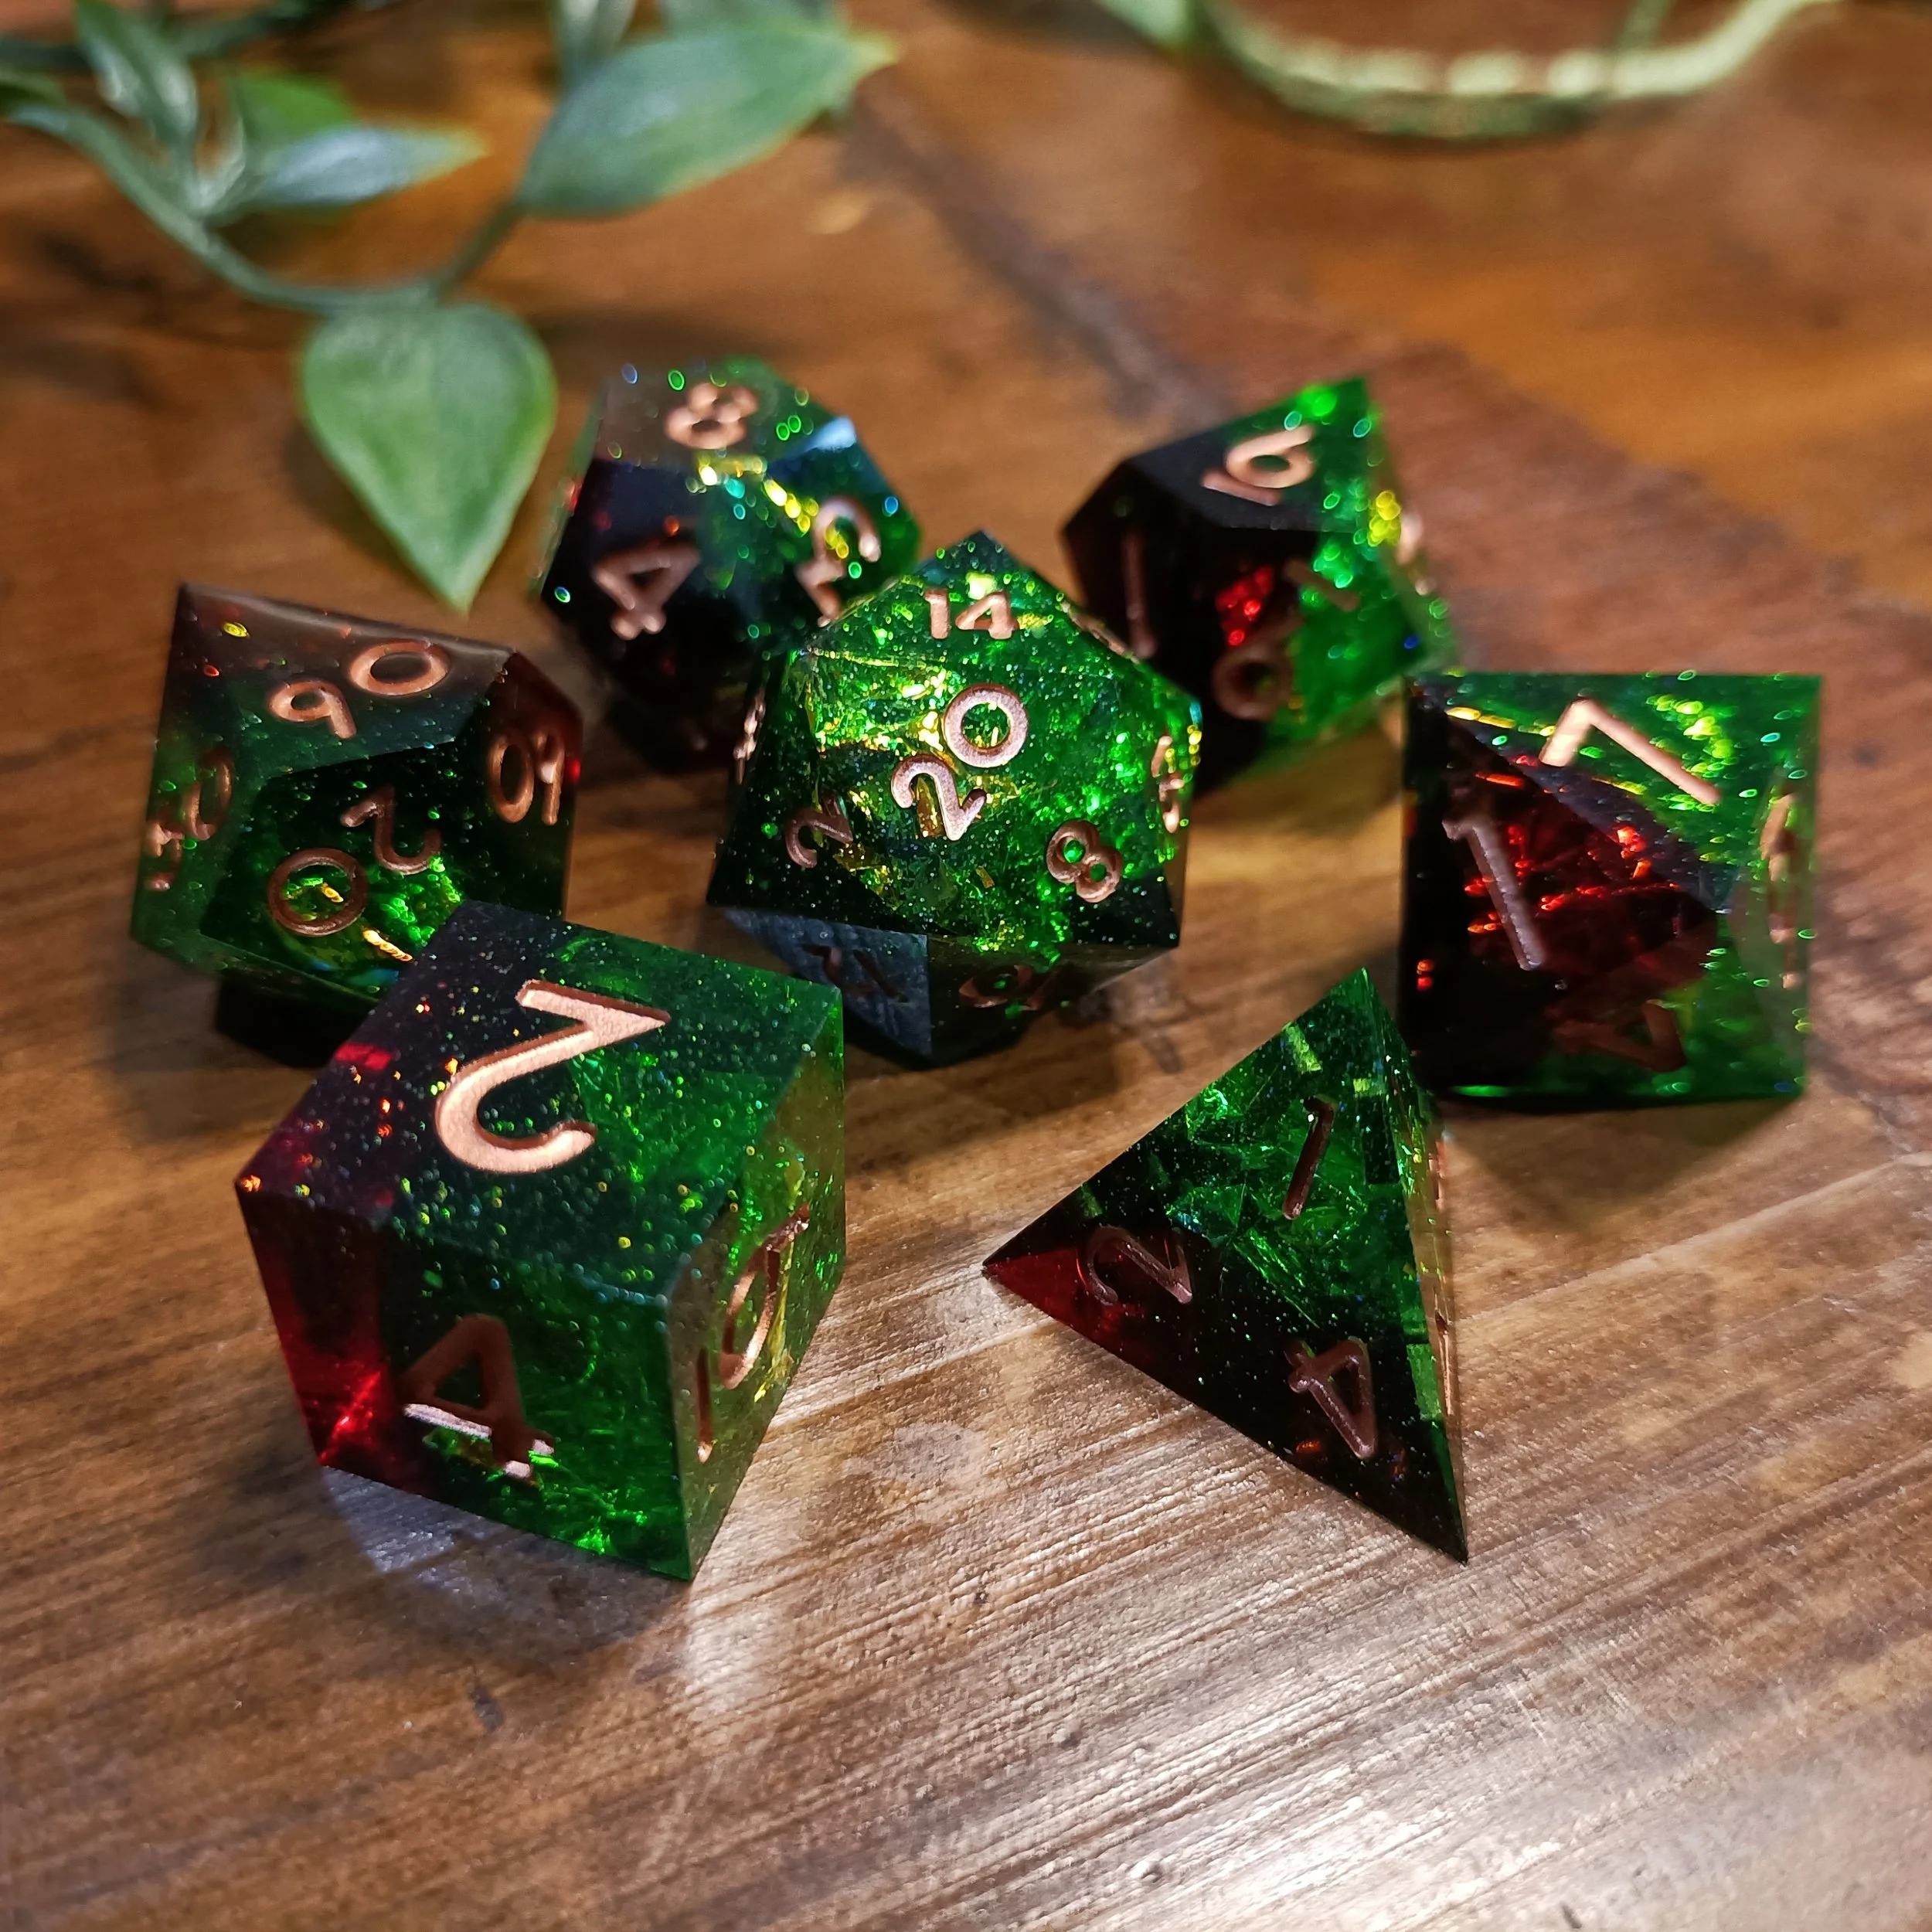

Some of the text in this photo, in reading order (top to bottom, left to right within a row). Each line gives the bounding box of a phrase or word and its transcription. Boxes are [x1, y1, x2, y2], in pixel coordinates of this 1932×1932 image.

[664, 383, 759, 451] 8
[924, 589, 1020, 639] 14
[267, 638, 453, 740] 90
[891, 683, 1029, 842] 20
[1541, 697, 1720, 804] 7
[267, 781, 443, 937] 20
[784, 791, 853, 869] 2
[1046, 819, 1123, 903] 8
[1442, 811, 1546, 971] 1
[435, 979, 672, 1173] 2
[1282, 1094, 1338, 1219] 1
[1084, 1225, 1192, 1305] 2
[398, 1314, 555, 1480] 4
[1284, 1336, 1377, 1459] 4
